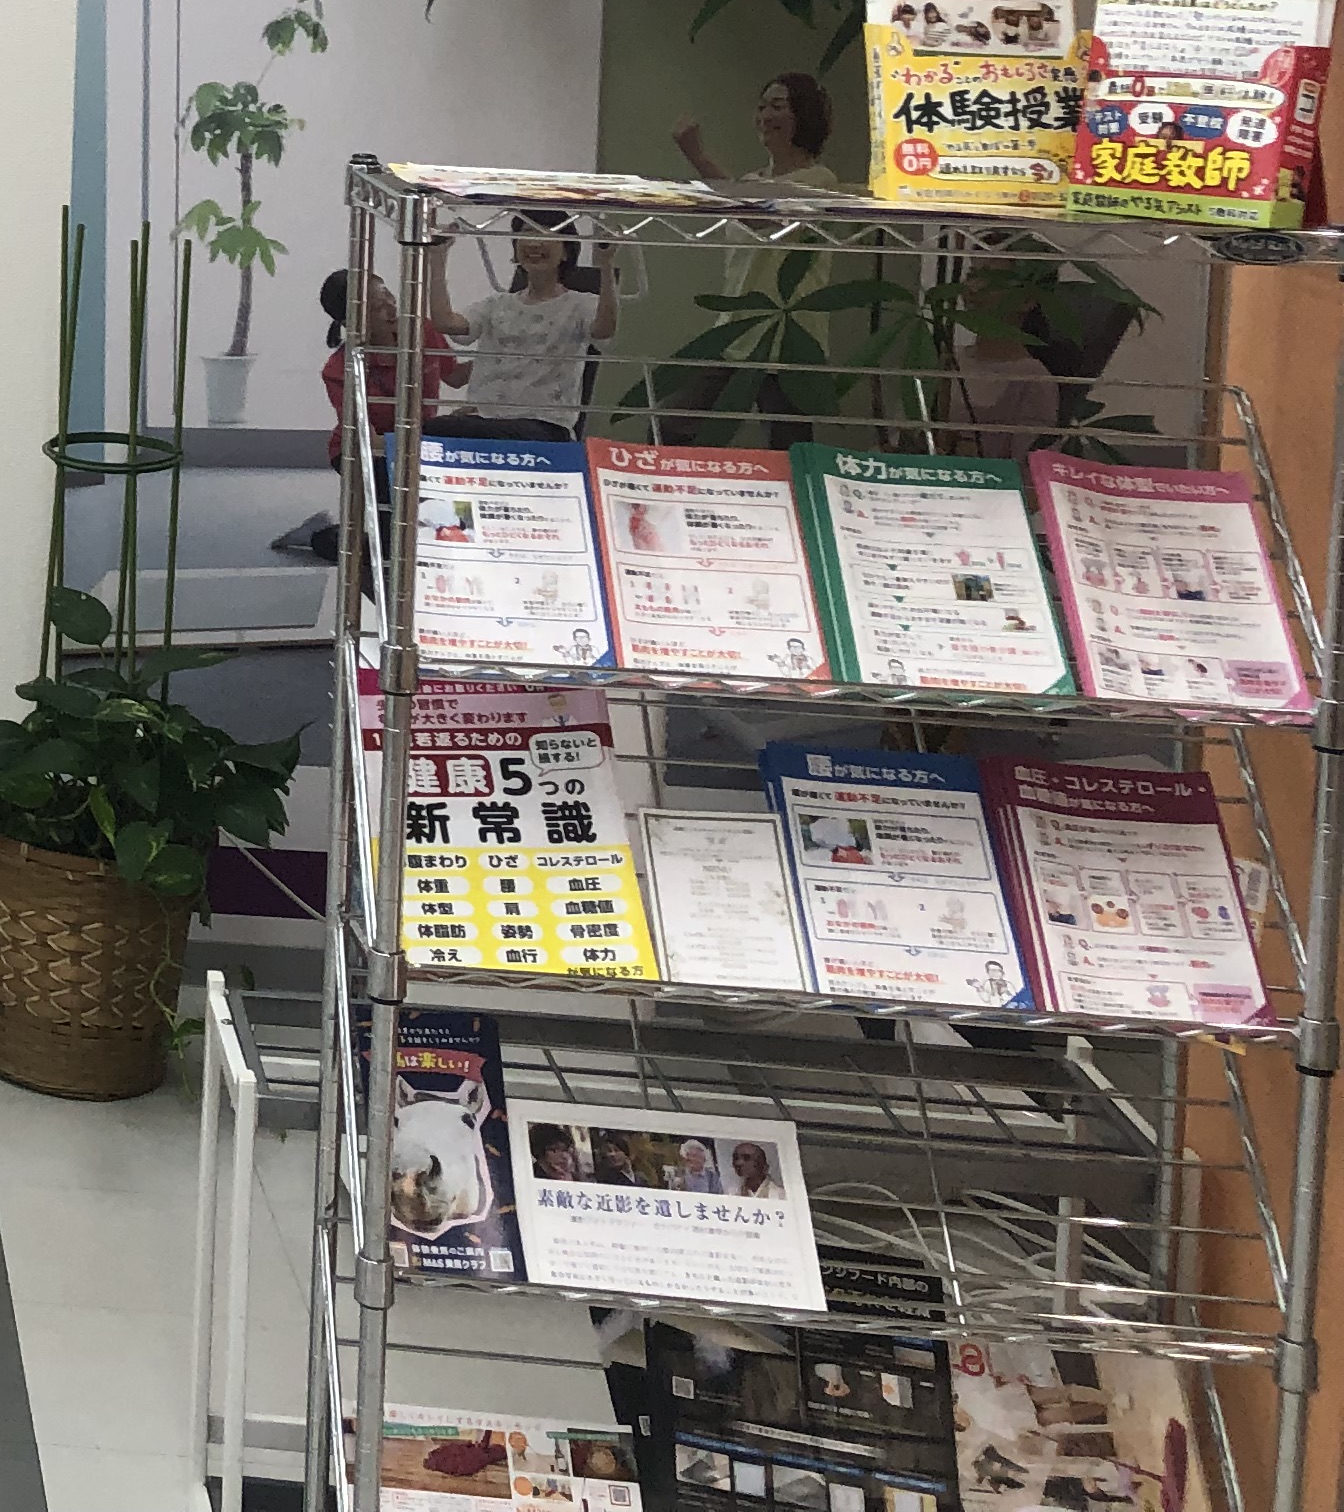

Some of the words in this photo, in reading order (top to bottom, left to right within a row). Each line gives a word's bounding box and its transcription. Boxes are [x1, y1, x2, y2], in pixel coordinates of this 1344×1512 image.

[893, 85, 1085, 134] 体験授業
[1091, 137, 1251, 191] 家庭教師
[609, 446, 770, 476] ひざが気になる方へ
[535, 738, 598, 751] 知らないと
[405, 800, 598, 846] 新常識
[487, 854, 519, 868] ひざ
[536, 854, 624, 867] コレステロール
[417, 878, 450, 894] 体重
[568, 877, 603, 892] 血圧
[421, 901, 455, 916] 体型
[503, 902, 521, 916] 肩
[564, 900, 615, 915] 血糖値
[417, 923, 467, 939] 体脂肪
[500, 924, 534, 939] 姿勢
[570, 922, 621, 938] 骨密度
[429, 948, 463, 963] 冷え
[505, 949, 539, 964] 血行
[582, 947, 617, 962] 体力
